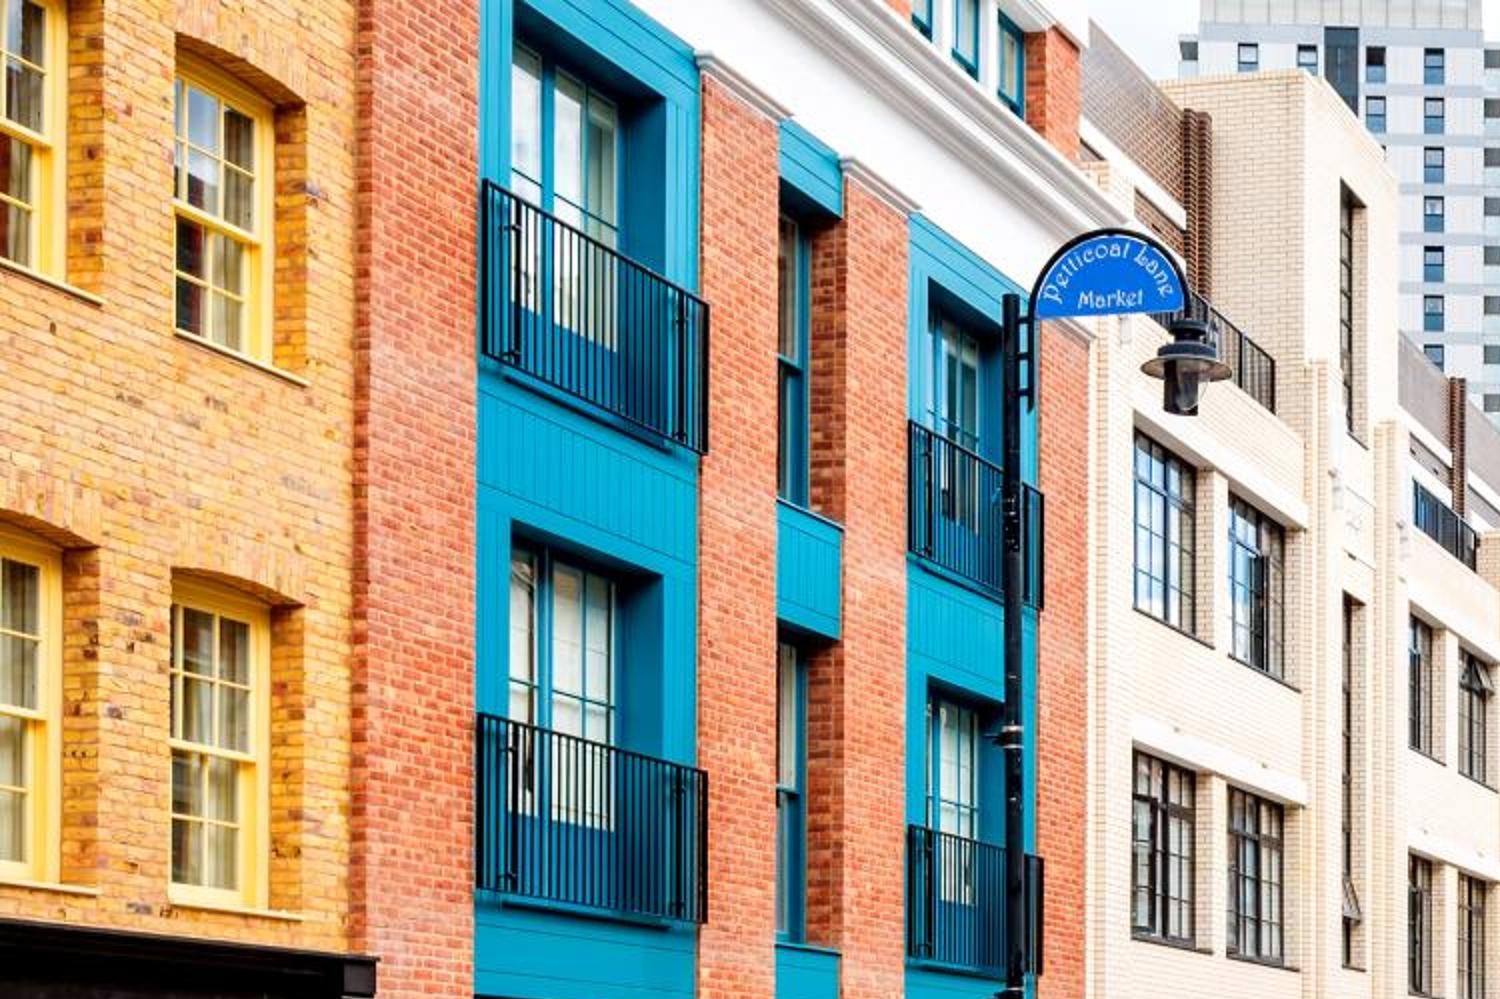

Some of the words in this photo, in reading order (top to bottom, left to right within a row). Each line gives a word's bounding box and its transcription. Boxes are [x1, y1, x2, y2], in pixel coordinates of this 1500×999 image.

[1043, 241, 1130, 304] Petticoat
[1134, 245, 1173, 297] Lane
[1078, 288, 1143, 309] Market
